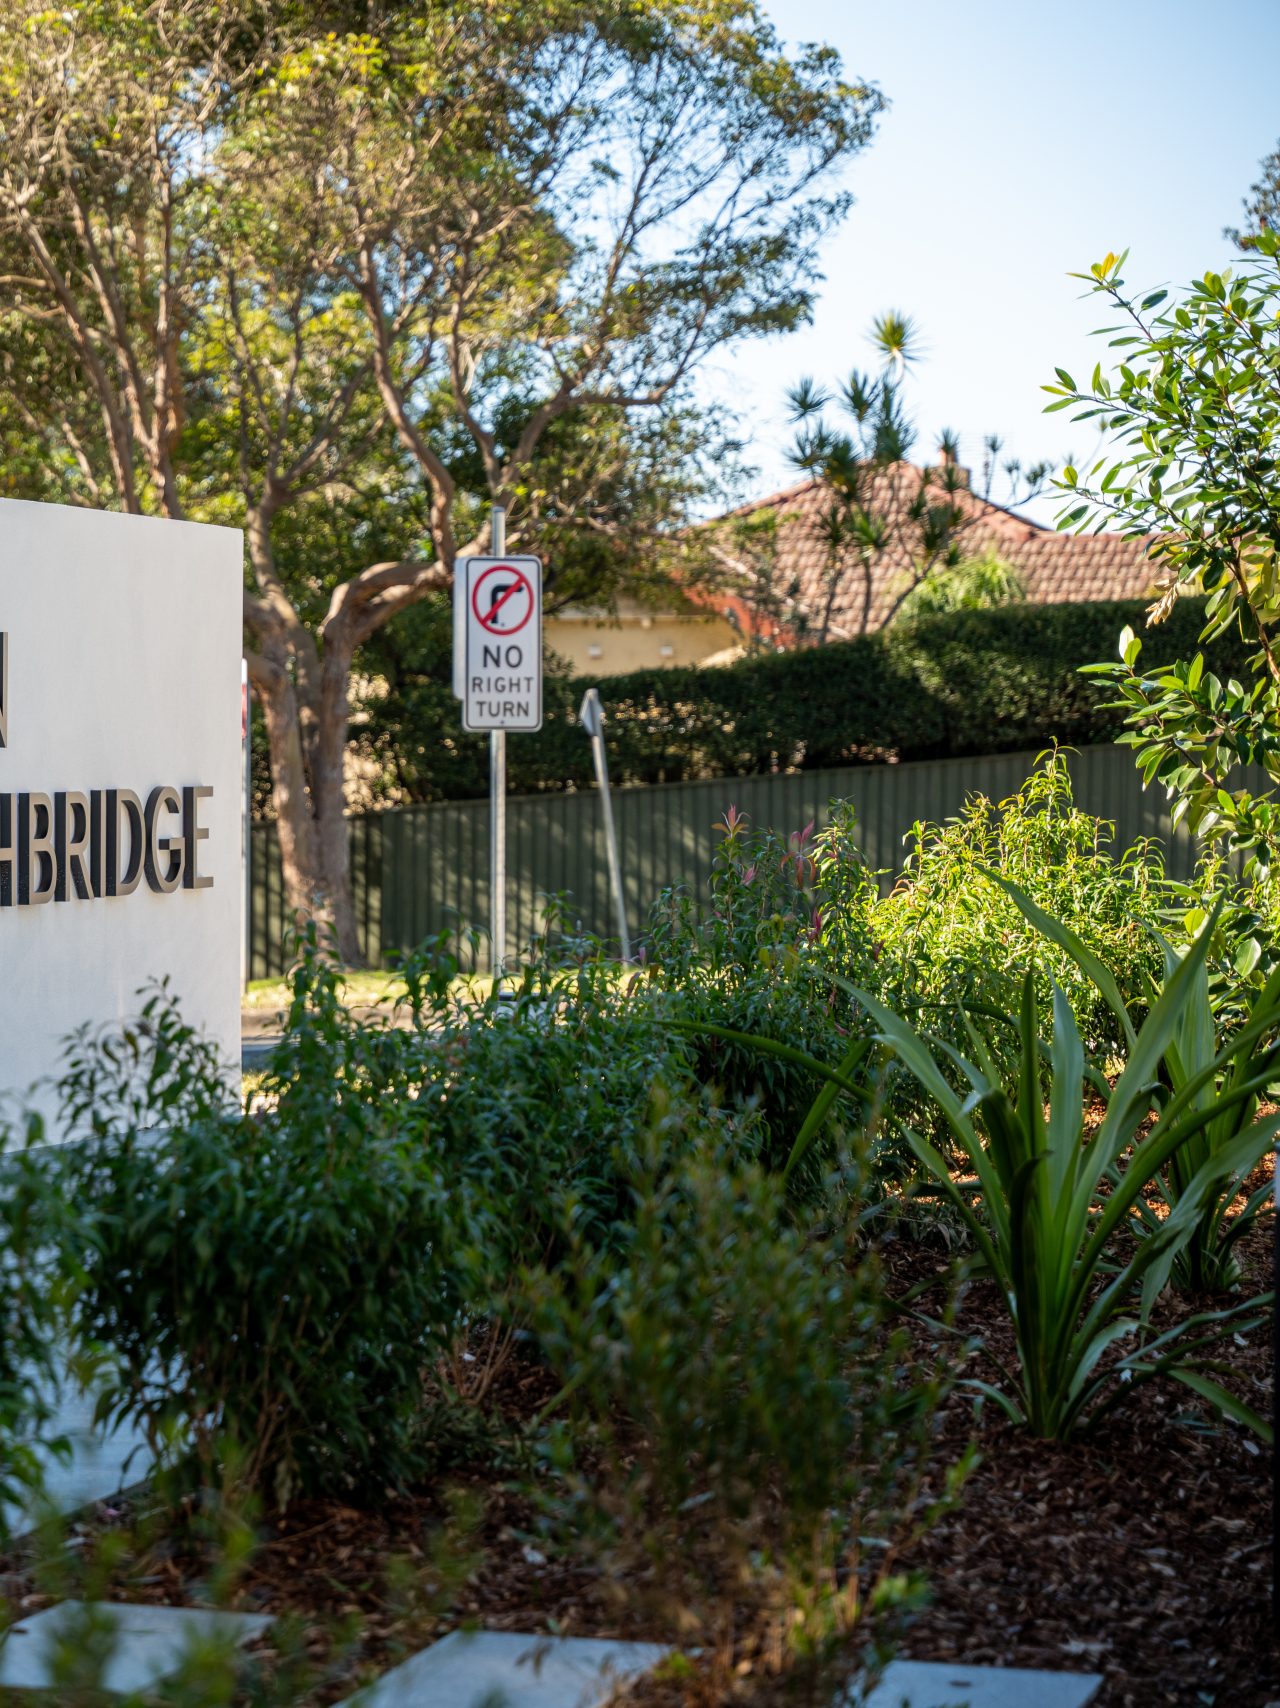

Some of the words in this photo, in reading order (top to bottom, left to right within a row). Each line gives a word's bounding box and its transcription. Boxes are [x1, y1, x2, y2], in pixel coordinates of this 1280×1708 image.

[483, 645, 523, 668] NO
[472, 677, 534, 693] RIGHT
[477, 701, 529, 717] TURN
